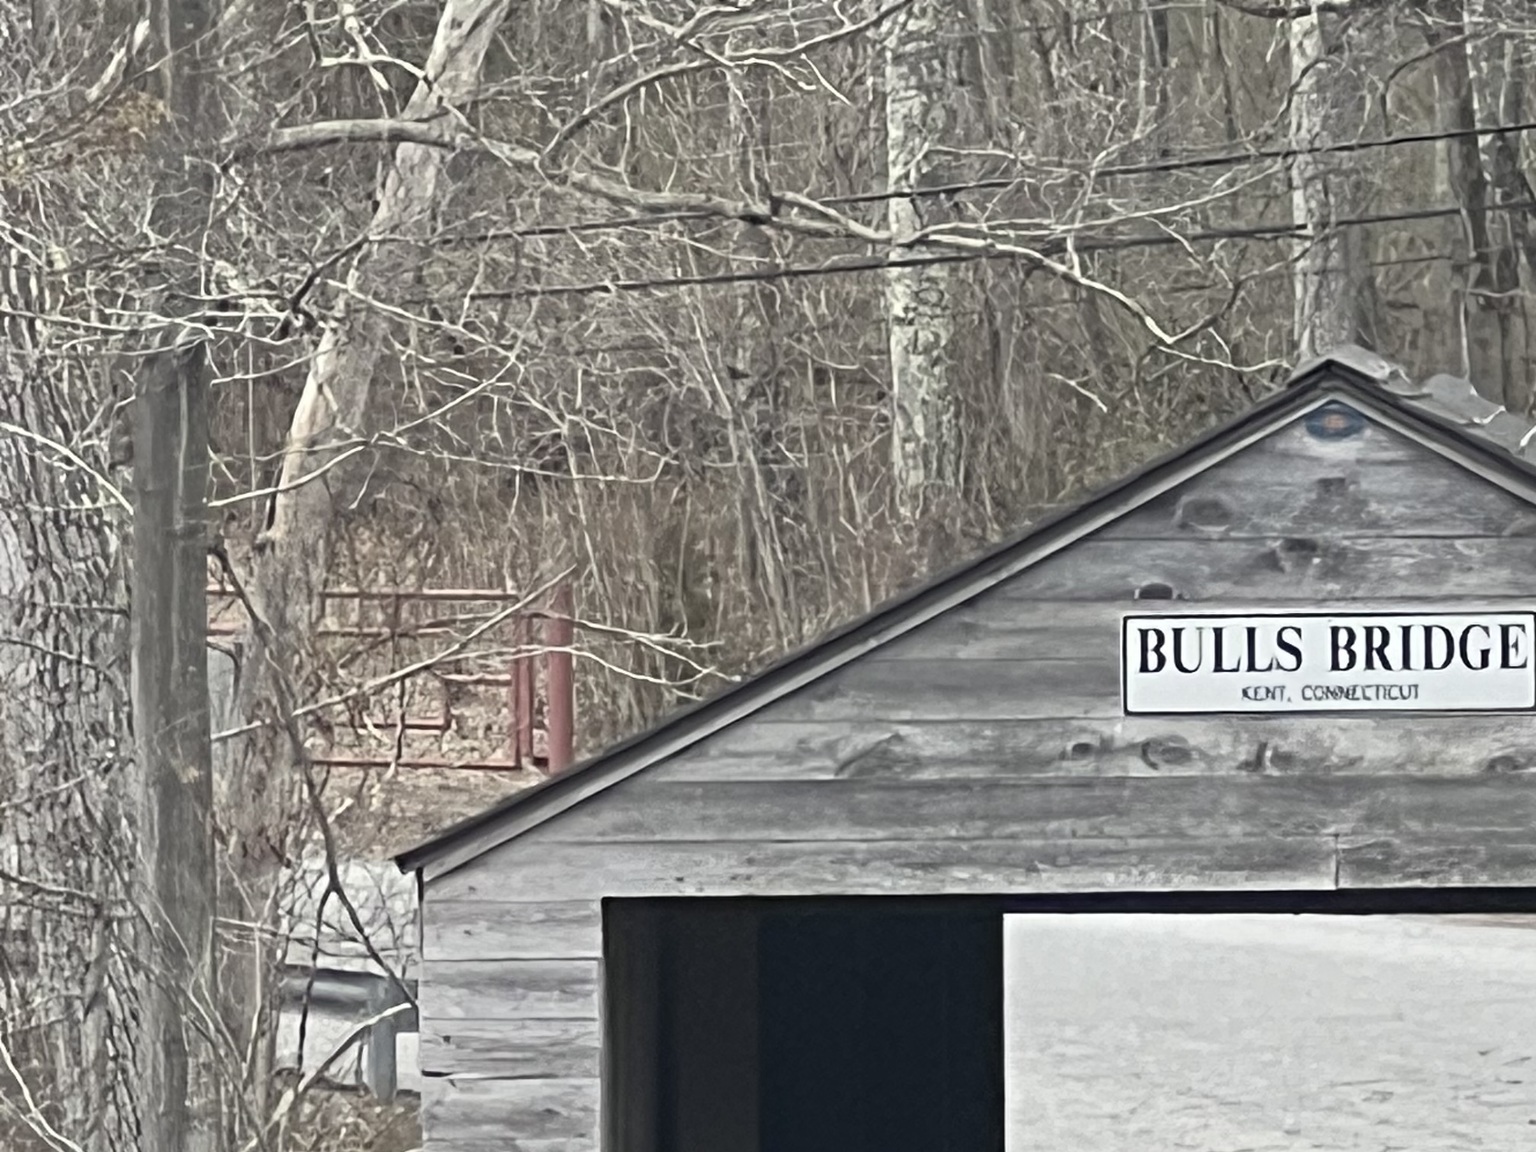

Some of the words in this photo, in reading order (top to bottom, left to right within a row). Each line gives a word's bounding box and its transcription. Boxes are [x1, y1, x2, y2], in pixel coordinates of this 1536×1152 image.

[1137, 625, 1303, 674] BULLS
[1329, 623, 1529, 672] BRIDGE
[1301, 683, 1420, 701] CONNECTICUT
